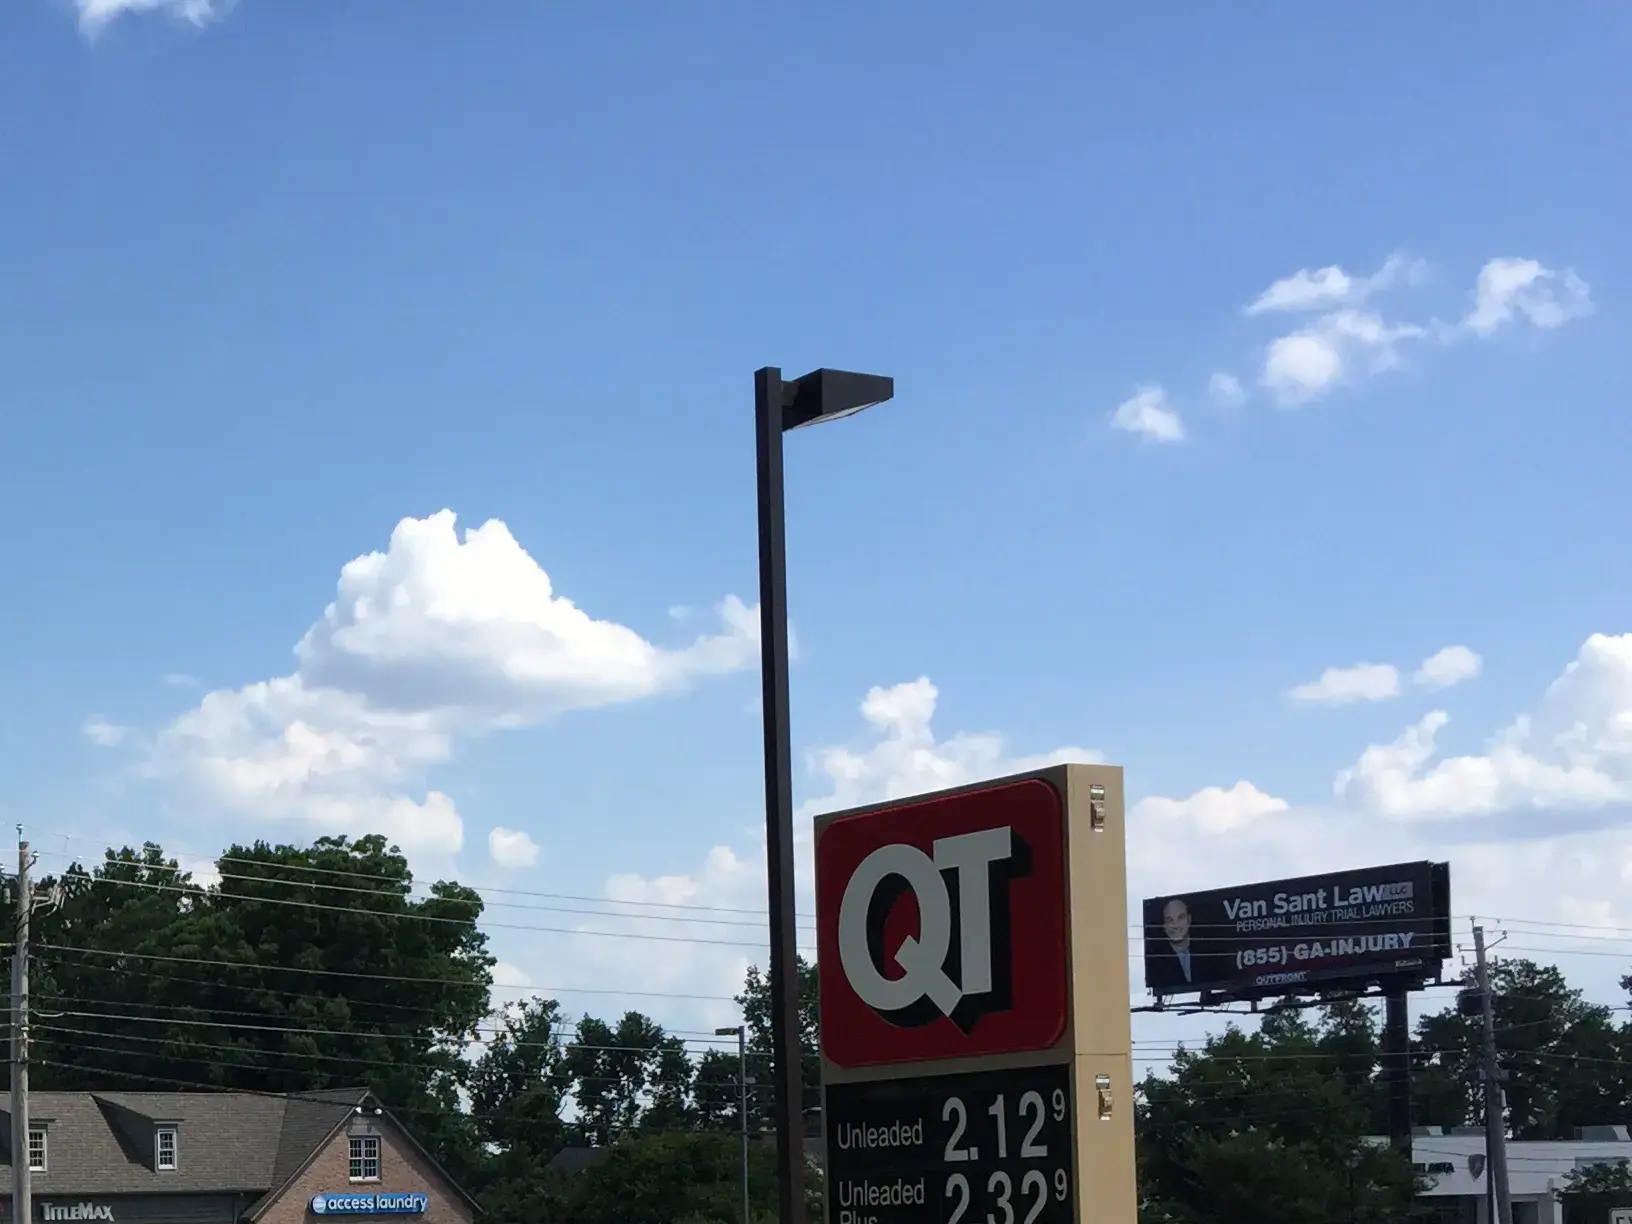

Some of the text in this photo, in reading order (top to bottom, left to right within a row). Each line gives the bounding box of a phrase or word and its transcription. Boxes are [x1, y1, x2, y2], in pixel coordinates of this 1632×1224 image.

[1223, 898, 1267, 920] Van
[1273, 888, 1328, 914] Sant
[1333, 884, 1386, 906] Law
[1236, 900, 1415, 933] PERSONAL INJURY TRIAL LAWYERS
[838, 825, 1012, 1018] QT
[1236, 932, 1415, 970] (855) GA-INJURY
[1255, 971, 1306, 985] OUTFRONT
[837, 1118, 923, 1149] Unleaded
[942, 1090, 1048, 1162] 2.12
[328, 1195, 428, 1212] access laundry
[839, 1178, 925, 1207] Unleaded
